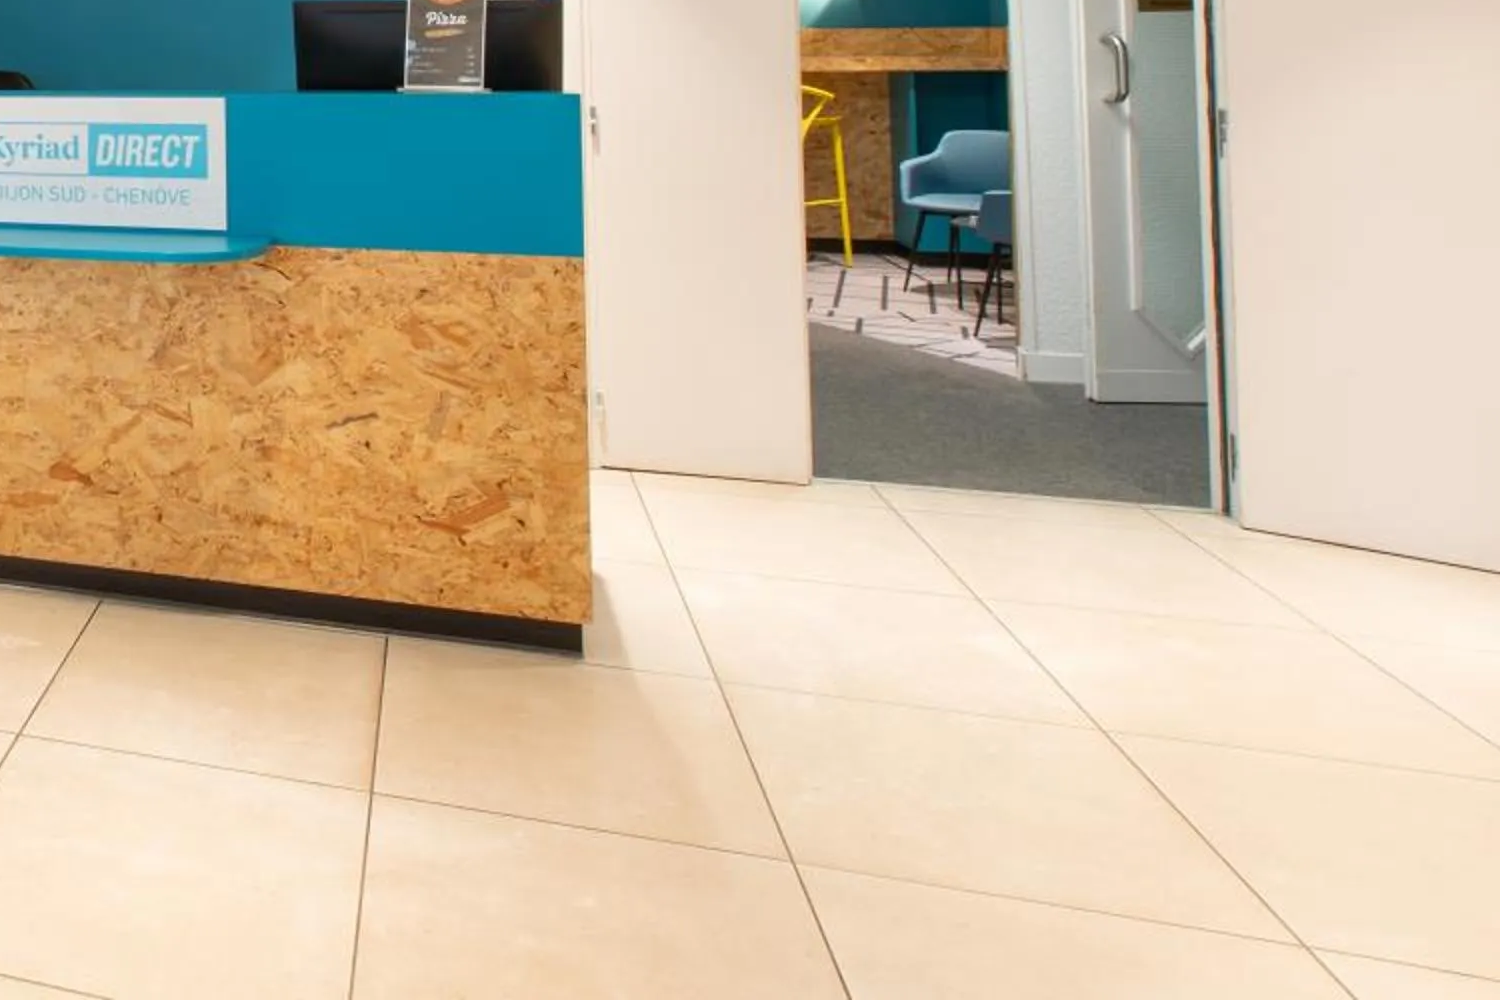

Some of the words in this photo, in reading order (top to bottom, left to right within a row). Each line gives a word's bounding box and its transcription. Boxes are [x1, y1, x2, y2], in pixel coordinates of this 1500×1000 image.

[425, 10, 469, 26] Pizza
[95, 132, 201, 169] DIRECT
[48, 183, 87, 203] SUD
